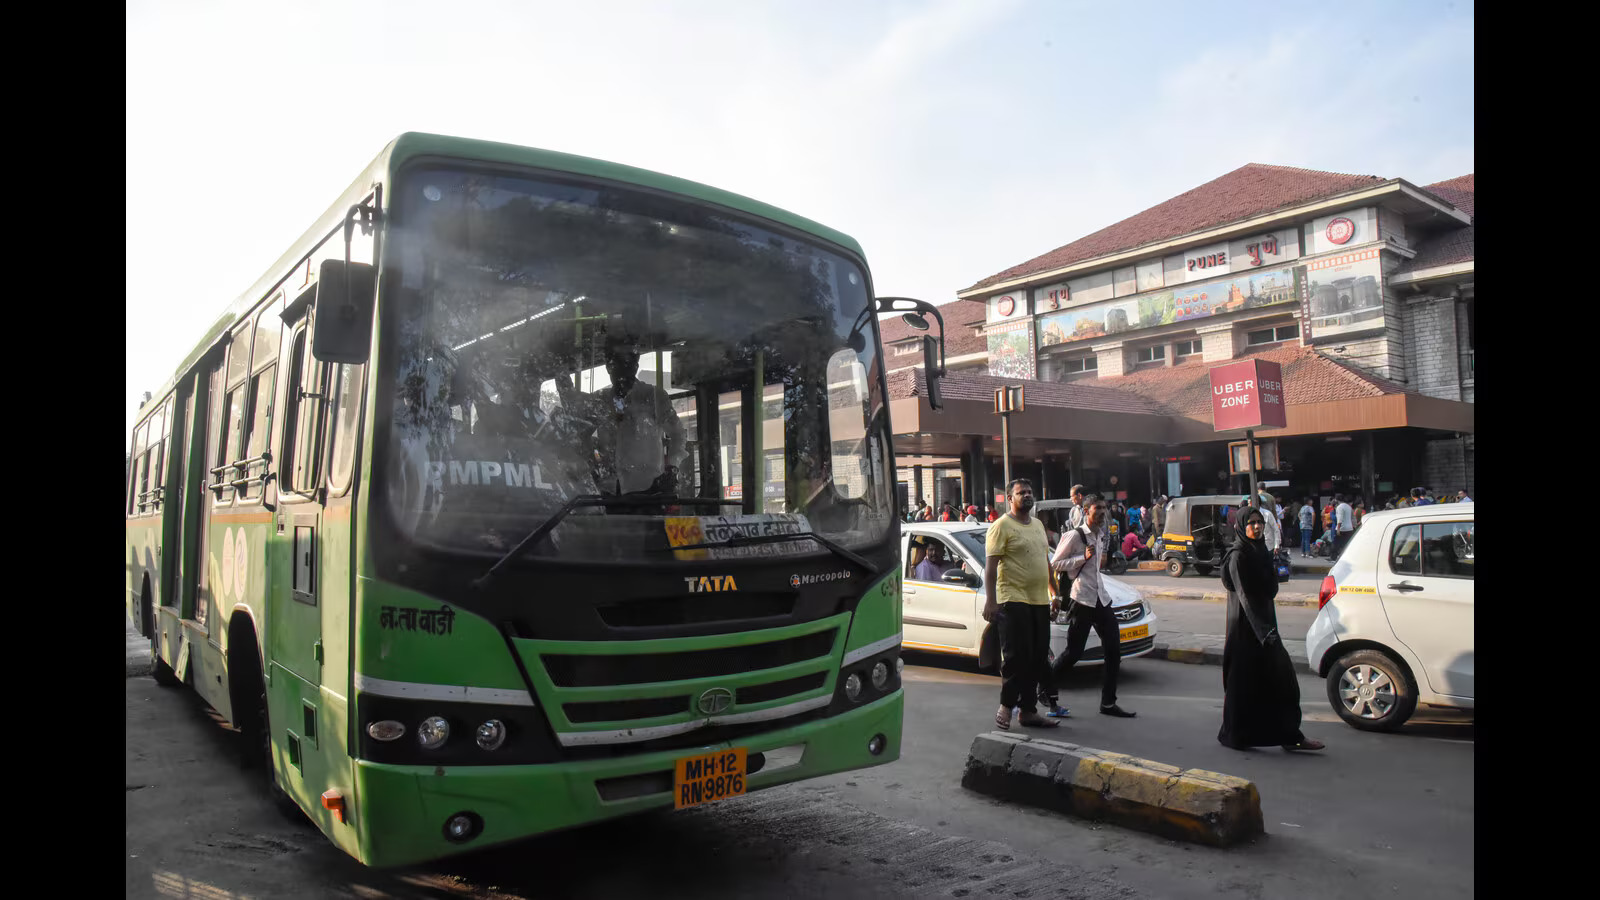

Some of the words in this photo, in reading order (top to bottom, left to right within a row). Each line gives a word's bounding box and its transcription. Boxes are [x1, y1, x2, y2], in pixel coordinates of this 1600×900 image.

[1246, 234, 1278, 266] पुणे
[1187, 252, 1225, 271] PUNE
[1048, 282, 1071, 310] पुणे
[1213, 380, 1254, 395] UBER
[1260, 379, 1281, 391] UBER
[1221, 394, 1250, 408] ZONE
[1263, 393, 1280, 405] ZONE
[685, 575, 738, 593] TATA
[802, 569, 851, 585] Marcopolo
